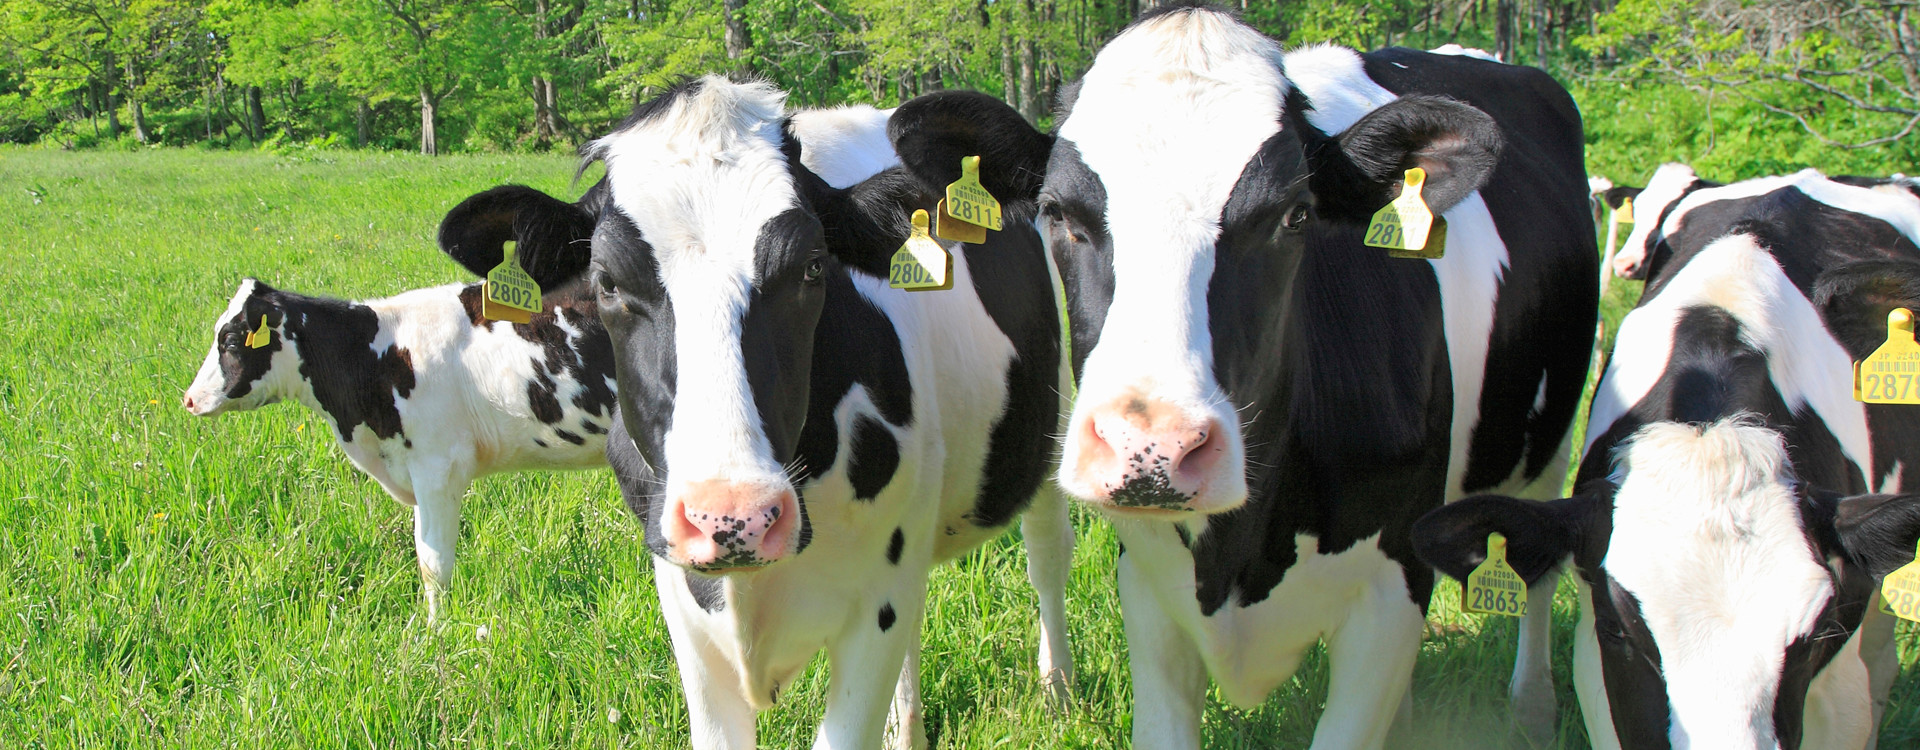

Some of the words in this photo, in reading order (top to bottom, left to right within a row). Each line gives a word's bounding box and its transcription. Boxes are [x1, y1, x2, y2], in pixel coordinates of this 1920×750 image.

[951, 197, 991, 226] 2811
[490, 280, 532, 309] 2802
[534, 299, 539, 310] 1
[1484, 569, 1491, 577] JP
[1472, 587, 1518, 613] 2863
[1521, 601, 1527, 615] 2
